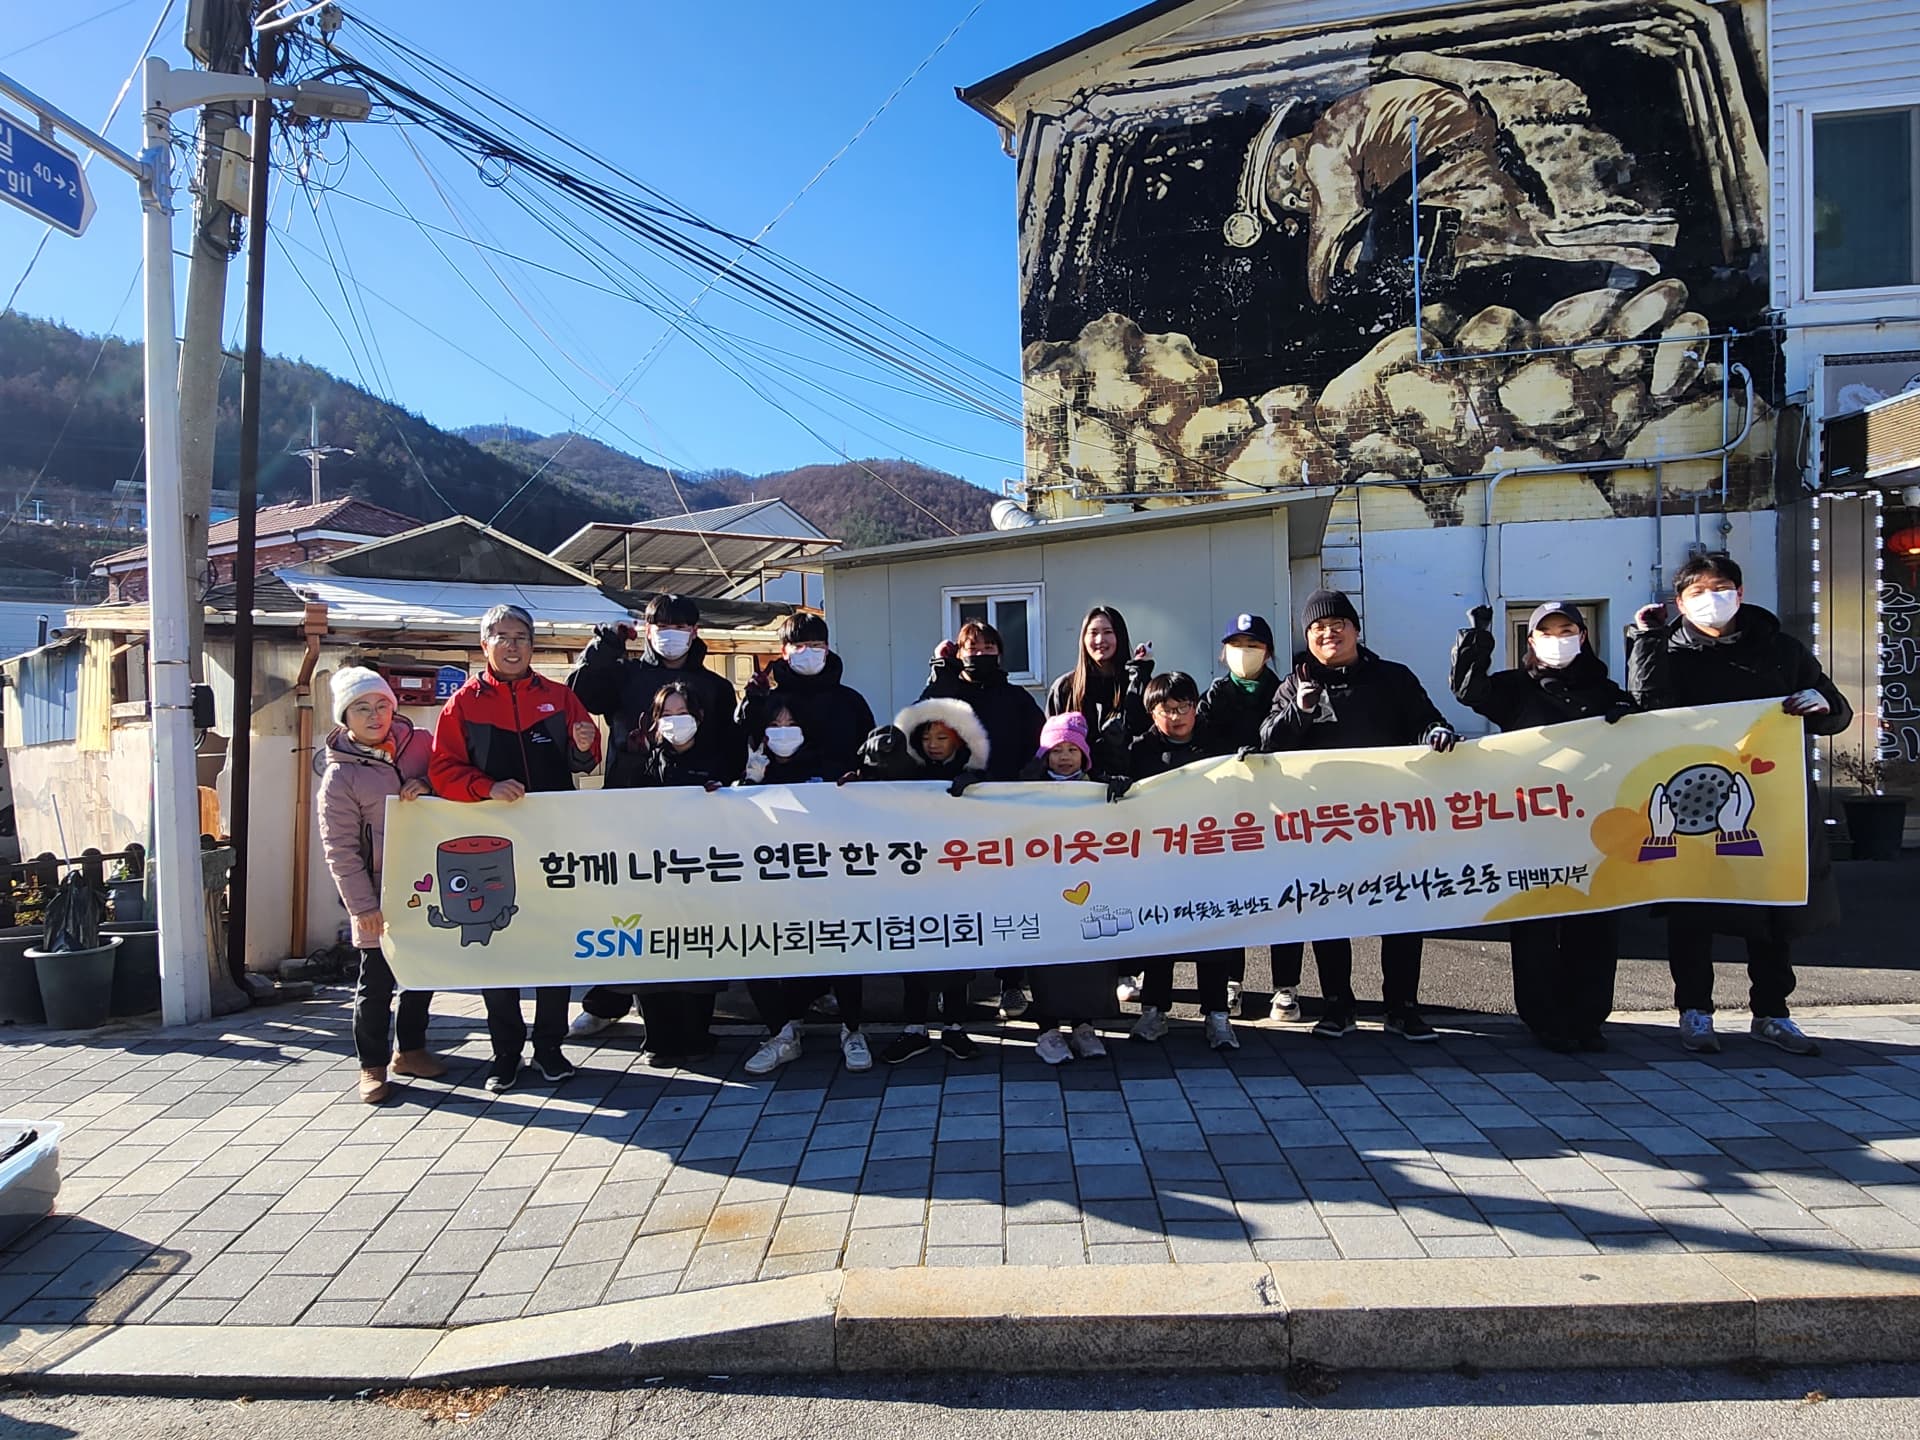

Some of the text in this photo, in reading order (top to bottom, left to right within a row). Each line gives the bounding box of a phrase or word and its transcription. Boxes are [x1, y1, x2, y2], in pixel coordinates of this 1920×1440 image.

[1237, 613, 1252, 631] C
[540, 783, 1586, 888] 함께 나누는 연탄 한 장 우리 이웃의 겨울을 따뜻하게 합니다.
[1138, 905, 1169, 926] (사)
[1278, 878, 1354, 914] 사랑의
[1508, 863, 1590, 892] 태백지부
[572, 912, 1041, 960] SSN 태백시사회복지협의회 부설
